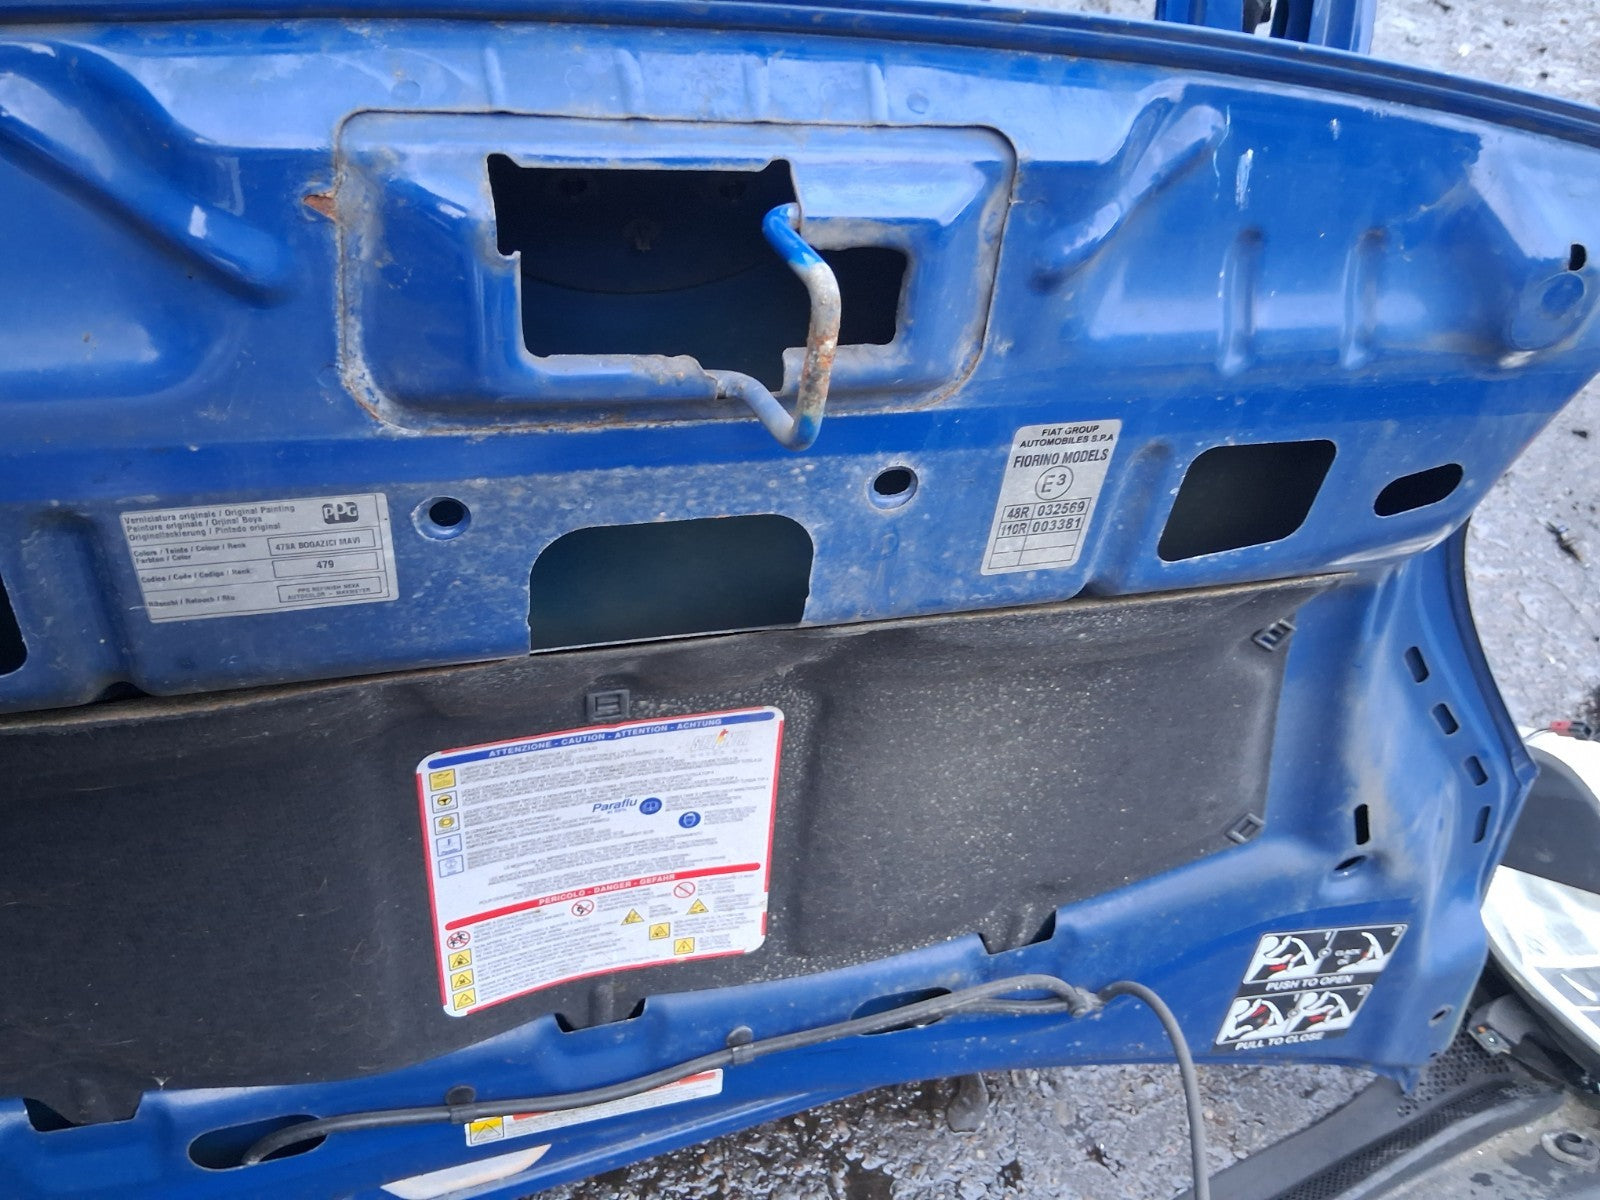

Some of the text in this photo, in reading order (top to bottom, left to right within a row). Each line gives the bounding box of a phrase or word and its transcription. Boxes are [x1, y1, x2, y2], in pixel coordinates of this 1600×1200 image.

[1041, 425, 1100, 437] FIAT GROUP
[1020, 436, 1089, 448] AUTOMOBILES
[1013, 448, 1110, 468] FIORINO MODELS
[179, 510, 216, 521] originale
[224, 507, 258, 517] Original
[260, 504, 295, 514] Painting
[323, 501, 359, 523] PPG
[1007, 501, 1086, 519] 48R 032569
[127, 522, 163, 533] Peinture
[166, 520, 203, 530] originale
[242, 515, 263, 524] Boya
[215, 525, 247, 534] Pintado
[250, 522, 281, 532] original
[1001, 517, 1081, 536] 110R 003381
[316, 559, 335, 569] 479
[488, 741, 552, 758] ATTENZIONE
[560, 732, 605, 746] CAUTION
[614, 725, 668, 739] ATTENTION
[676, 718, 722, 730] ACHTUNG
[538, 890, 586, 905] PERICOLO
[593, 881, 632, 895] DANGER
[639, 873, 676, 885] GEFAHR
[1265, 974, 1354, 991] PUSH TO OPEN
[1235, 1031, 1326, 1050] PULL TO CLOSE
